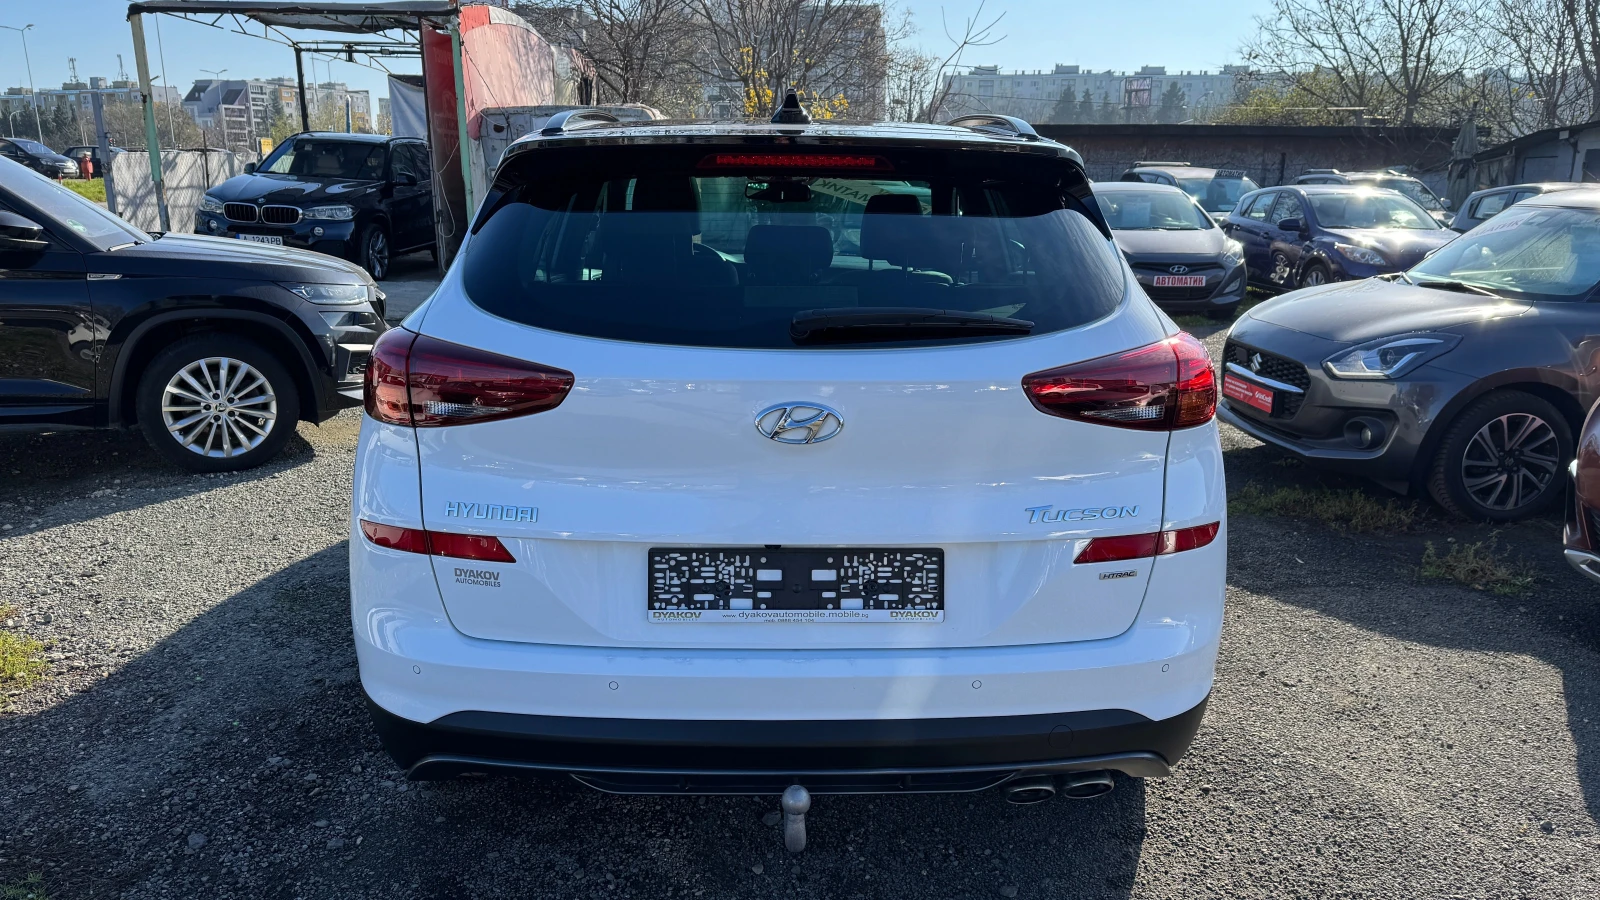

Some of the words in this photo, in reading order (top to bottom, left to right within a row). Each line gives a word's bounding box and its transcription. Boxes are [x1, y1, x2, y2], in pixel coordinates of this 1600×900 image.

[1155, 276, 1204, 286] АВТОМАТИК
[444, 501, 538, 523] HYUNDAI
[1025, 504, 1140, 524] TUCSON
[454, 567, 500, 581] DYAKOV
[1102, 571, 1135, 579] HTRAC
[455, 577, 501, 588] AUTOMOBILES
